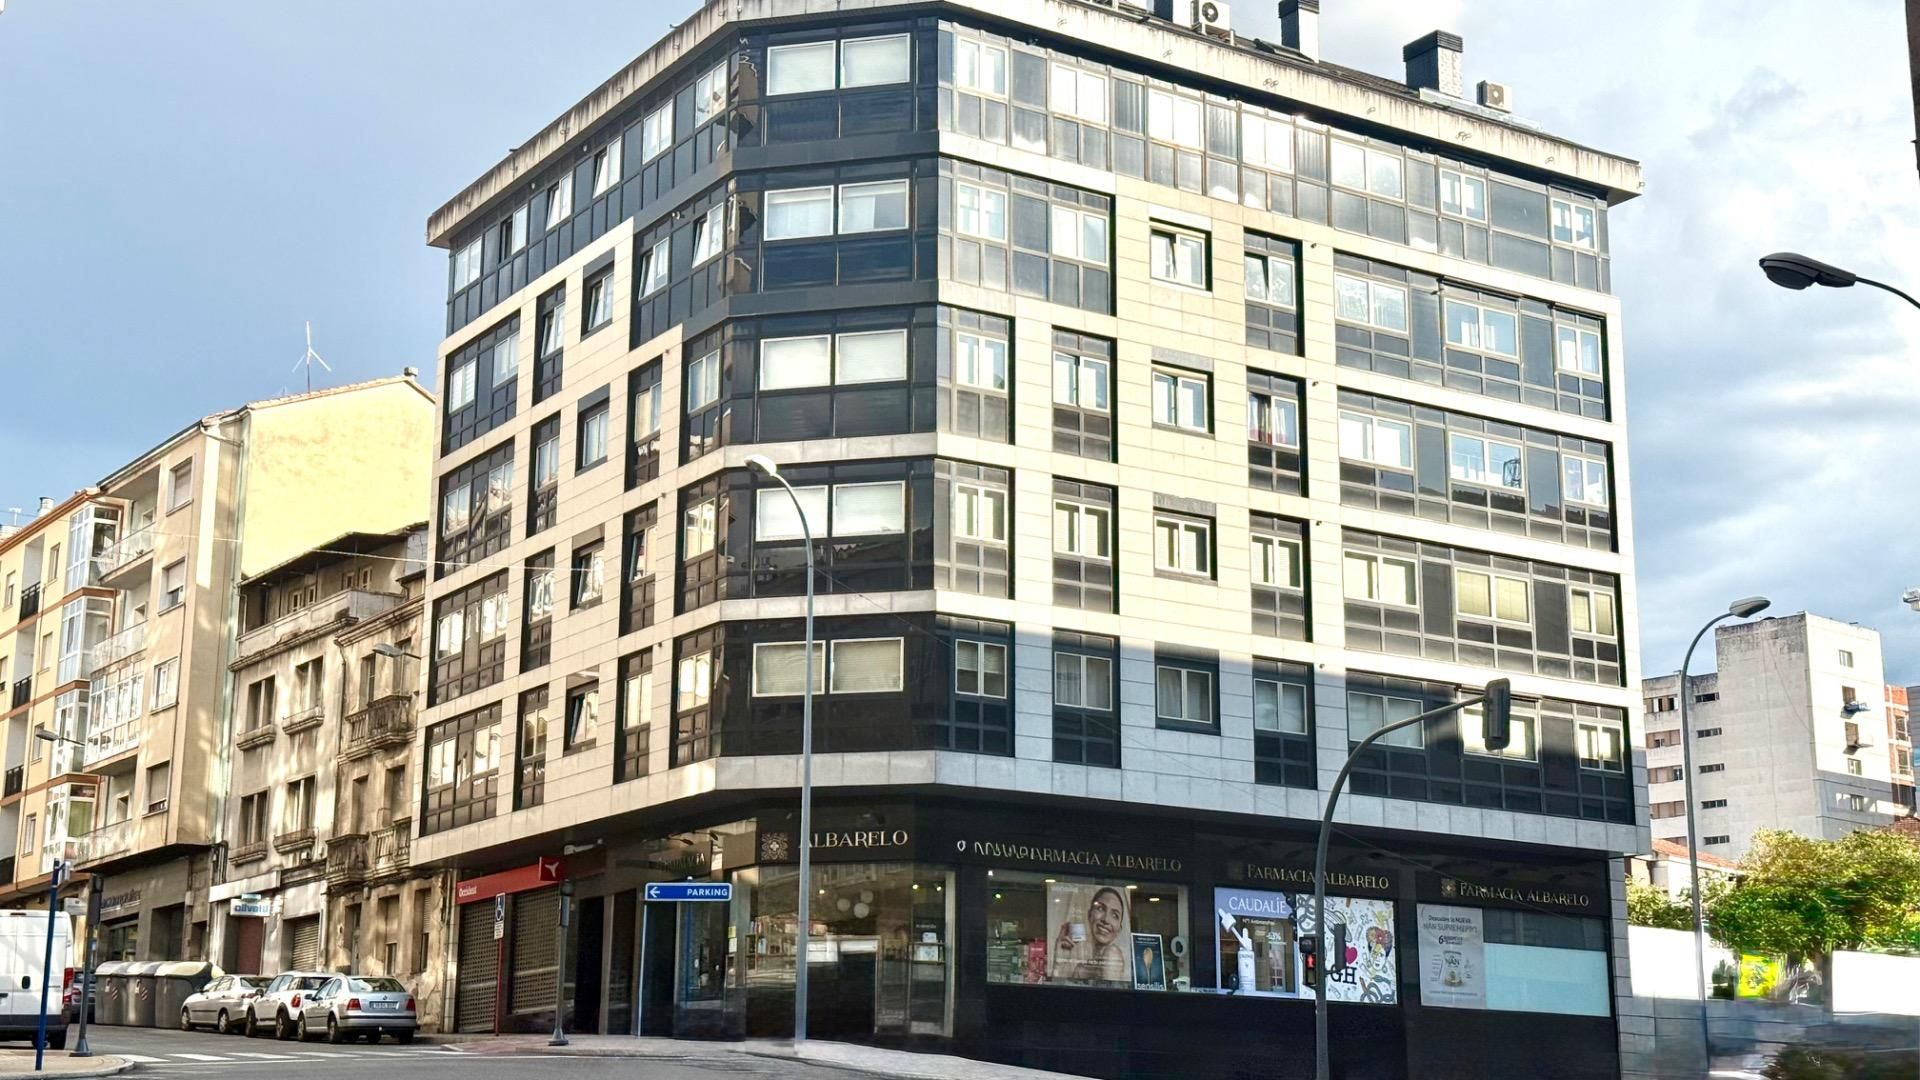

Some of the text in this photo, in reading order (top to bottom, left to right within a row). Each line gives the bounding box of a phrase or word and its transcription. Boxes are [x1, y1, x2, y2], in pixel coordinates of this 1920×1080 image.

[1106, 853, 1182, 872] ALBARELO
[1247, 864, 1316, 882] FARMACIA
[687, 888, 728, 897] PARKING
[1526, 887, 1590, 906] ALBARELO
